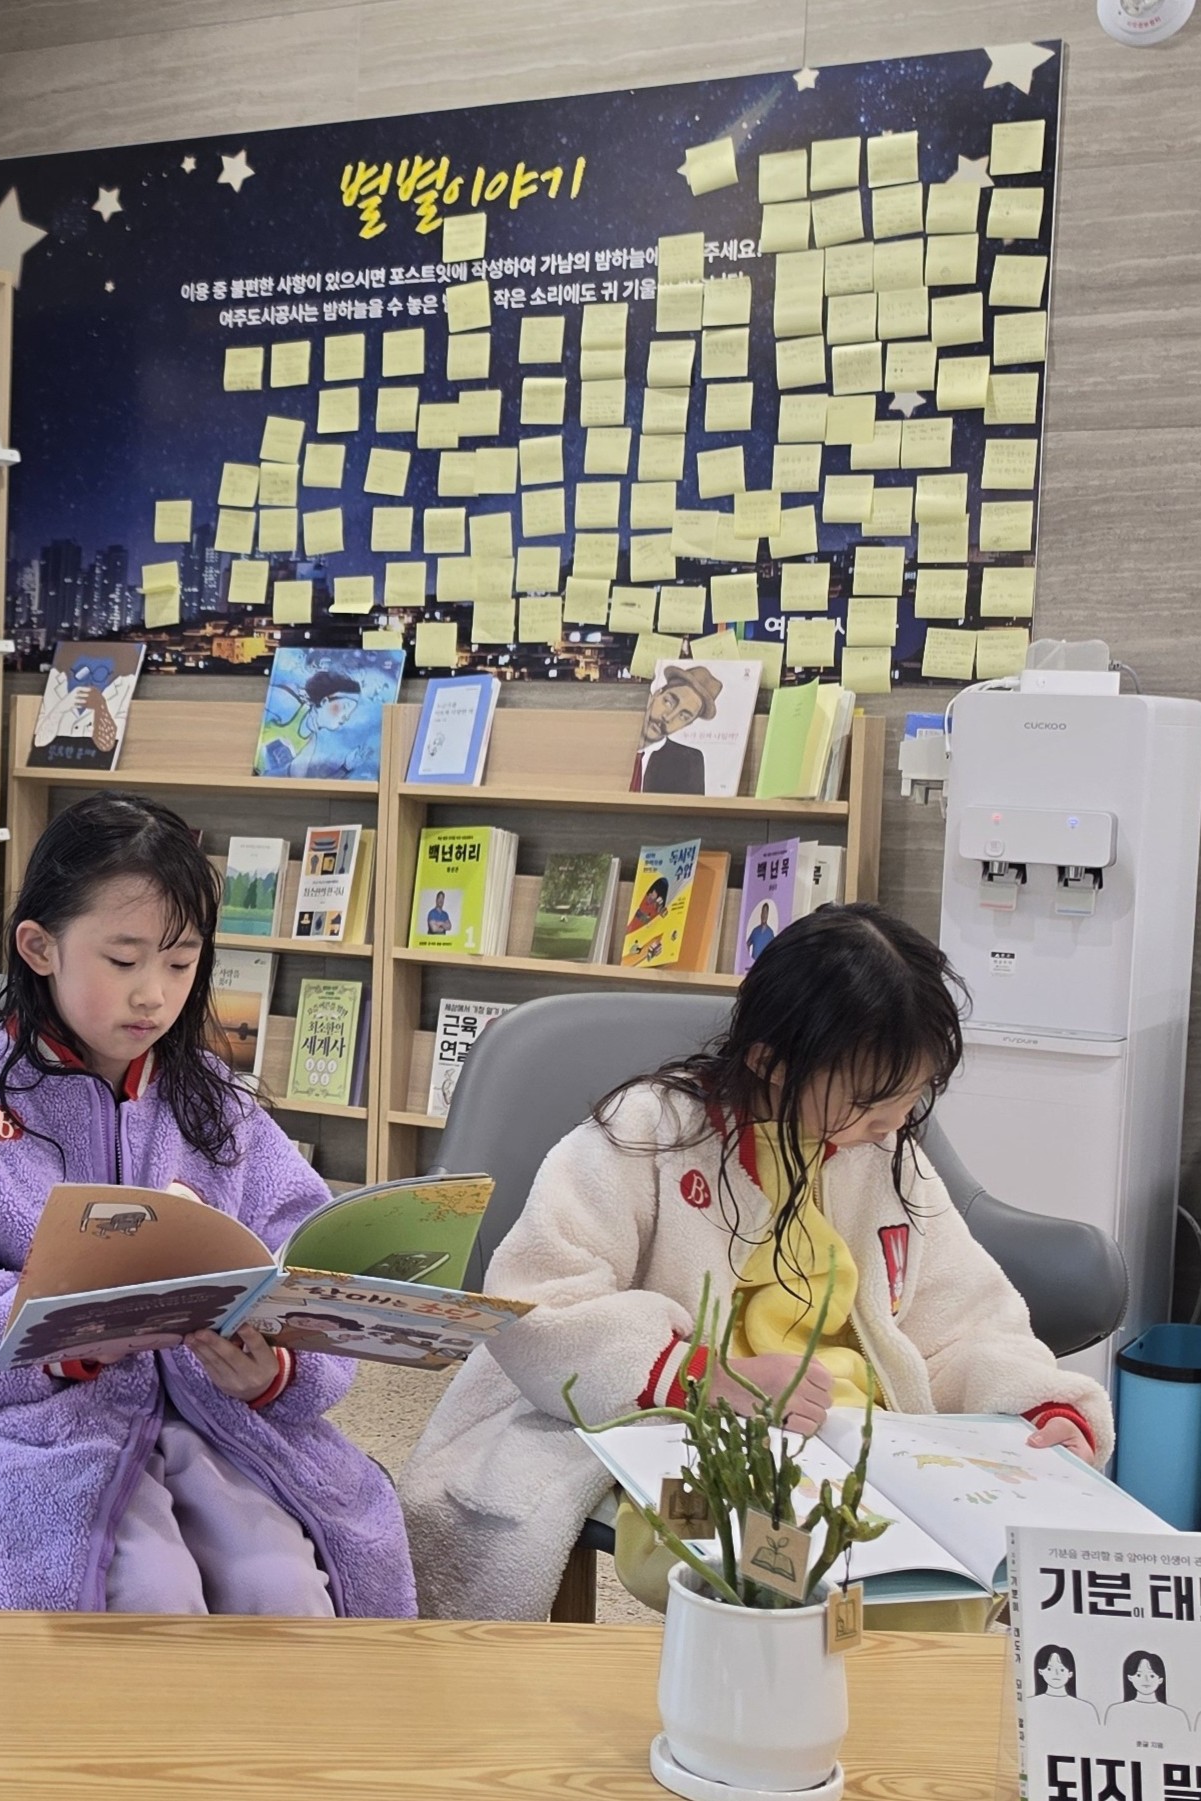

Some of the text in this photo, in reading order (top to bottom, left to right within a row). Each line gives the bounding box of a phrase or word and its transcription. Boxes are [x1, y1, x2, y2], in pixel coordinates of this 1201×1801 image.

[180, 282, 210, 303] 이용
[212, 281, 228, 300] 중
[230, 277, 274, 299] 불편한
[277, 272, 322, 294] 사항이
[324, 269, 386, 292] 있으시면
[388, 262, 468, 286] 포스트잇에
[471, 255, 536, 280] 작성하여
[540, 250, 590, 275] 가남의
[219, 308, 319, 328] 여주도시공사는
[323, 300, 384, 321] 밤하늘을
[387, 299, 403, 316] 수
[406, 294, 437, 314] 놓은
[493, 288, 526, 309] 작은
[529, 282, 597, 307] 소리에도
[600, 281, 618, 301] 귀
[1023, 721, 1067, 731] CUCKOO
[428, 843, 481, 863] 백년허리
[675, 862, 694, 880] 수업
[756, 857, 789, 881] 백년목
[464, 926, 476, 948] 1
[308, 1021, 344, 1037] 최소한의
[443, 1014, 477, 1038] 근육
[301, 1035, 346, 1059] 세계사
[1048, 1547, 1191, 1567] 기분을 관리할 줄 알아야 인생이
[1039, 1567, 1201, 1622] 기분이 태
